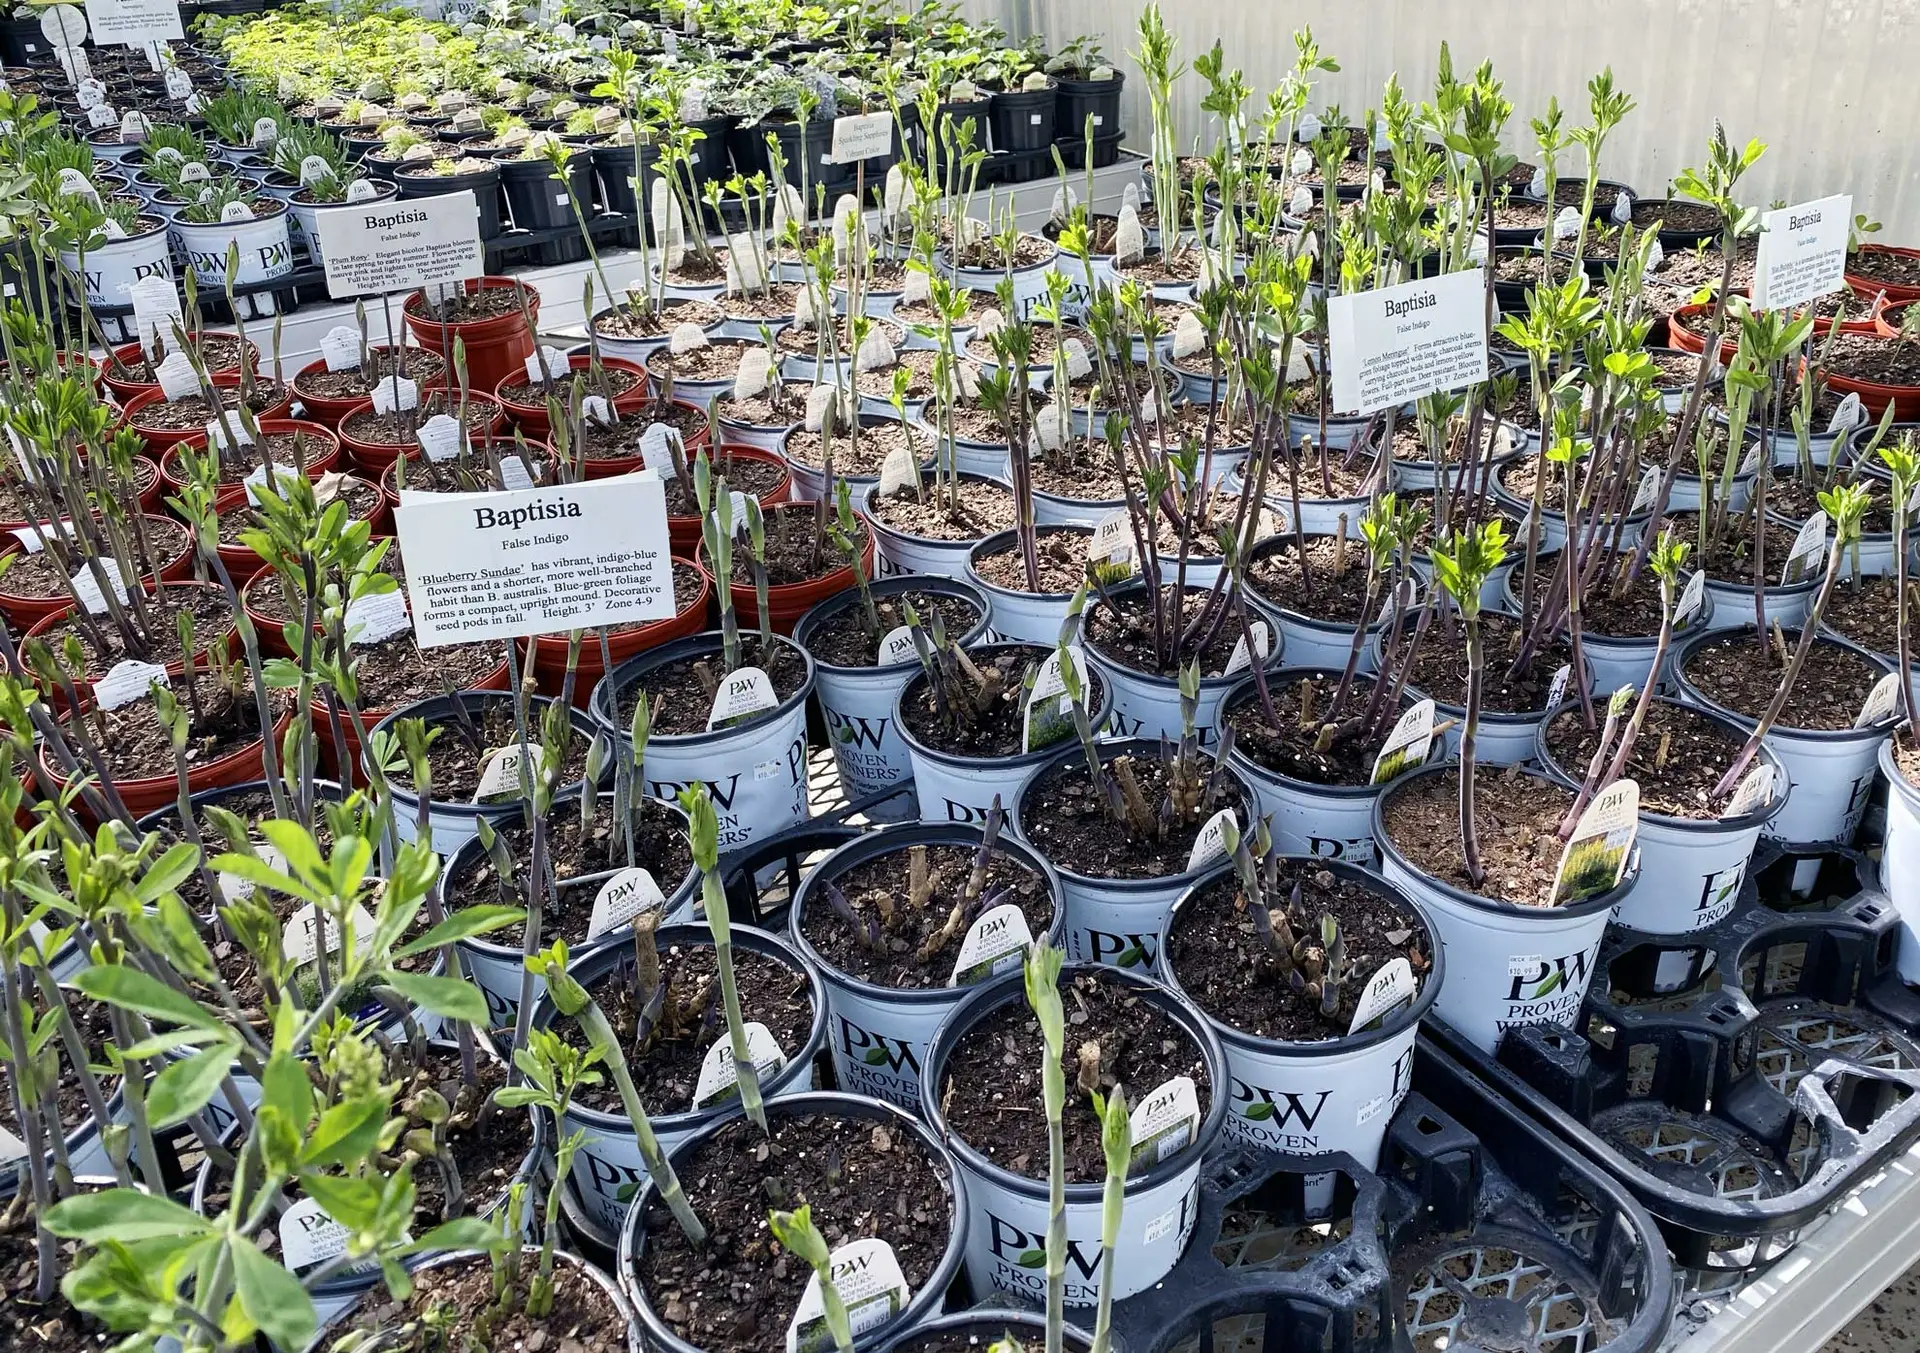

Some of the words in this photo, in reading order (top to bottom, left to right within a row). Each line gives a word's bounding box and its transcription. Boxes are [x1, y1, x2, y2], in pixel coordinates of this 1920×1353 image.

[306, 160, 323, 171] PW
[365, 209, 428, 230] Baptisia
[1789, 209, 1821, 231] Baptisia
[376, 250, 400, 260] Elegant
[402, 246, 424, 254] bicolor
[426, 242, 451, 253] Baptisia
[453, 238, 476, 247] blooms
[399, 231, 421, 240] Indigo
[190, 251, 228, 274] PW
[256, 239, 290, 269] PW
[331, 271, 352, 279] mauve
[354, 269, 368, 277] pink
[384, 263, 406, 273] lighten
[431, 257, 448, 265] white
[450, 255, 464, 263] with
[341, 263, 353, 271] late
[355, 261, 376, 270] spring
[386, 257, 401, 266] early
[432, 249, 457, 258] Flowers
[458, 246, 473, 256] open
[348, 276, 361, 284] Full
[371, 273, 384, 282] part
[357, 280, 380, 290] Height
[423, 272, 443, 280] Zones
[1384, 290, 1437, 318] Baptisia
[1397, 325, 1411, 334] False
[1412, 320, 1431, 330] Indigo
[1414, 344, 1432, 352] Forms
[1433, 336, 1459, 347] attractive
[1460, 332, 1476, 341] blue-
[1373, 362, 1390, 374] foliage
[1391, 358, 1409, 369] topped
[1439, 344, 1463, 355] charcoal
[1465, 340, 1482, 348] stems
[1419, 371, 1431, 380] Deer
[1458, 360, 1481, 369] Blooms
[1365, 374, 1386, 386] carrying
[1387, 368, 1409, 379] charcoal
[1411, 364, 1423, 373] buds
[1373, 393, 1389, 405] spring
[1394, 388, 1408, 399] early
[1453, 372, 1469, 381] Zone
[1470, 368, 1480, 376] 4-9
[473, 496, 583, 531] Baptisia
[502, 538, 531, 551] False
[533, 532, 569, 546] Indigo
[1102, 520, 1122, 538] PW
[531, 561, 550, 572] has
[552, 556, 593, 570] vibrant,
[596, 550, 658, 567] indigo-blue
[427, 583, 468, 597] flowers
[470, 580, 491, 592] and
[494, 581, 500, 590] a
[503, 575, 544, 589] shorter,
[547, 570, 575, 582] more
[577, 561, 652, 578] well-branched
[430, 596, 458, 608] habit
[461, 593, 485, 605] than
[487, 591, 500, 601] B.
[503, 584, 551, 600] australis.
[554, 578, 613, 594] Blue-green
[615, 573, 652, 588] foliage
[423, 608, 455, 622] forms
[458, 609, 465, 617] a
[467, 602, 517, 618] compact,
[520, 597, 558, 612] upright
[561, 591, 600, 604] mound.
[604, 584, 662, 599] Decorative
[435, 620, 460, 632] seed
[463, 617, 488, 630] pods
[491, 615, 502, 625] in
[505, 611, 527, 624] fall.
[542, 605, 582, 619] Height.
[605, 598, 633, 611] Zone
[635, 596, 653, 609] 4-9
[889, 636, 914, 654] PW
[729, 677, 758, 696] PW
[824, 706, 889, 752] PW
[1600, 790, 1630, 811] PW
[606, 877, 638, 906] PW
[979, 913, 1012, 940] PW
[1373, 966, 1401, 996] PW
[1502, 940, 1600, 1000] PW
[1507, 986, 1584, 1018] PROVEN
[836, 1012, 929, 1079] PW
[1147, 1087, 1182, 1116] PW
[1231, 1076, 1334, 1132] PW
[1226, 1115, 1319, 1150] PROVEN
[831, 1251, 876, 1281] PW
[996, 1261, 1099, 1299] PROEN
